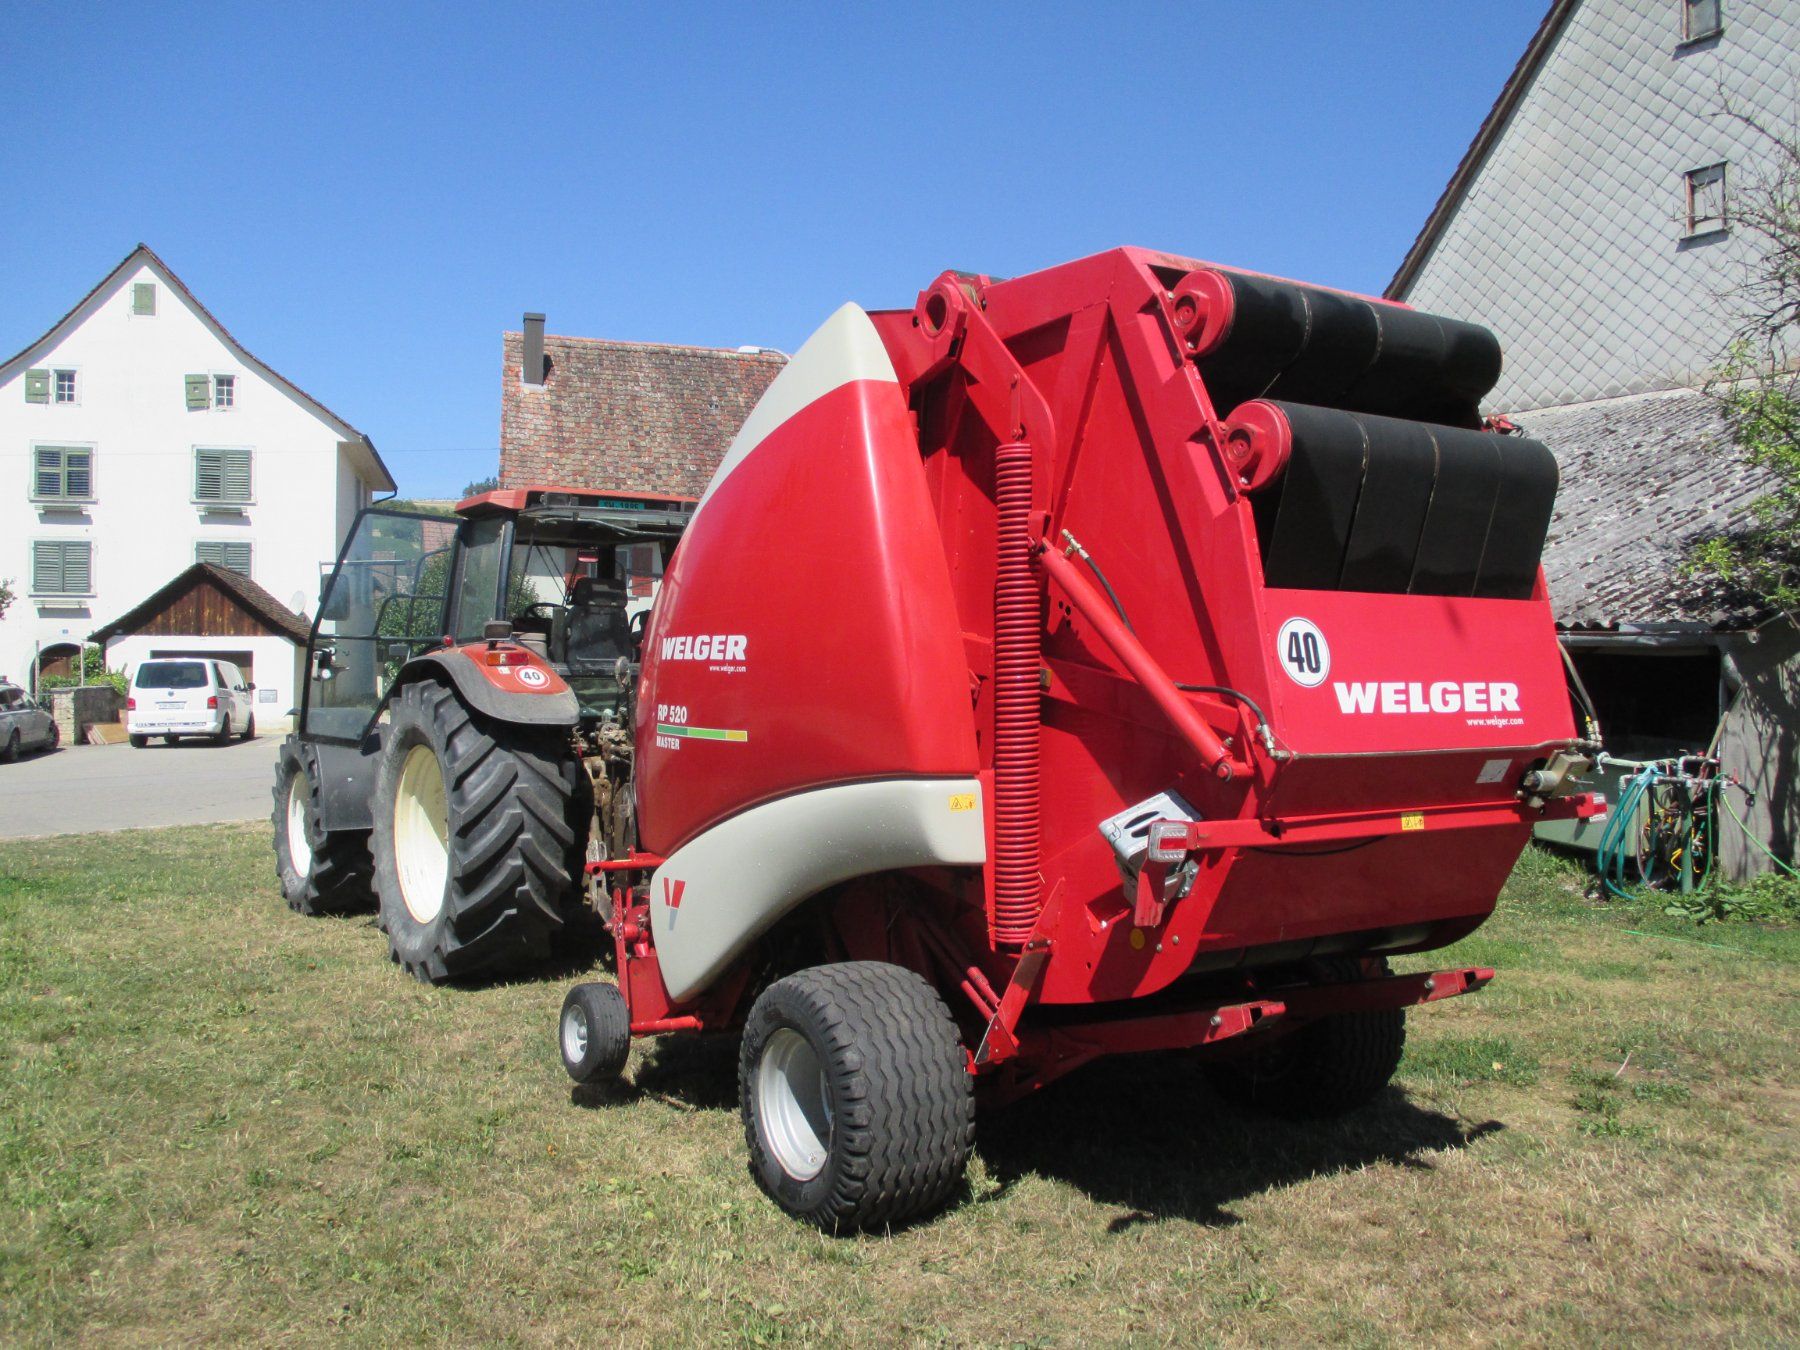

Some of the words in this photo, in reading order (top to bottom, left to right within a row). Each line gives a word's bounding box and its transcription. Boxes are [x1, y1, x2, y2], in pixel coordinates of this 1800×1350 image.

[661, 634, 748, 661] WELGER
[1287, 631, 1321, 674] 40
[523, 671, 541, 681] 40
[1333, 681, 1521, 714] WELGER
[657, 703, 669, 721] RP
[669, 705, 688, 724] 520
[1466, 715, 1525, 729] www.welger.com
[656, 735, 680, 750] MASTER
